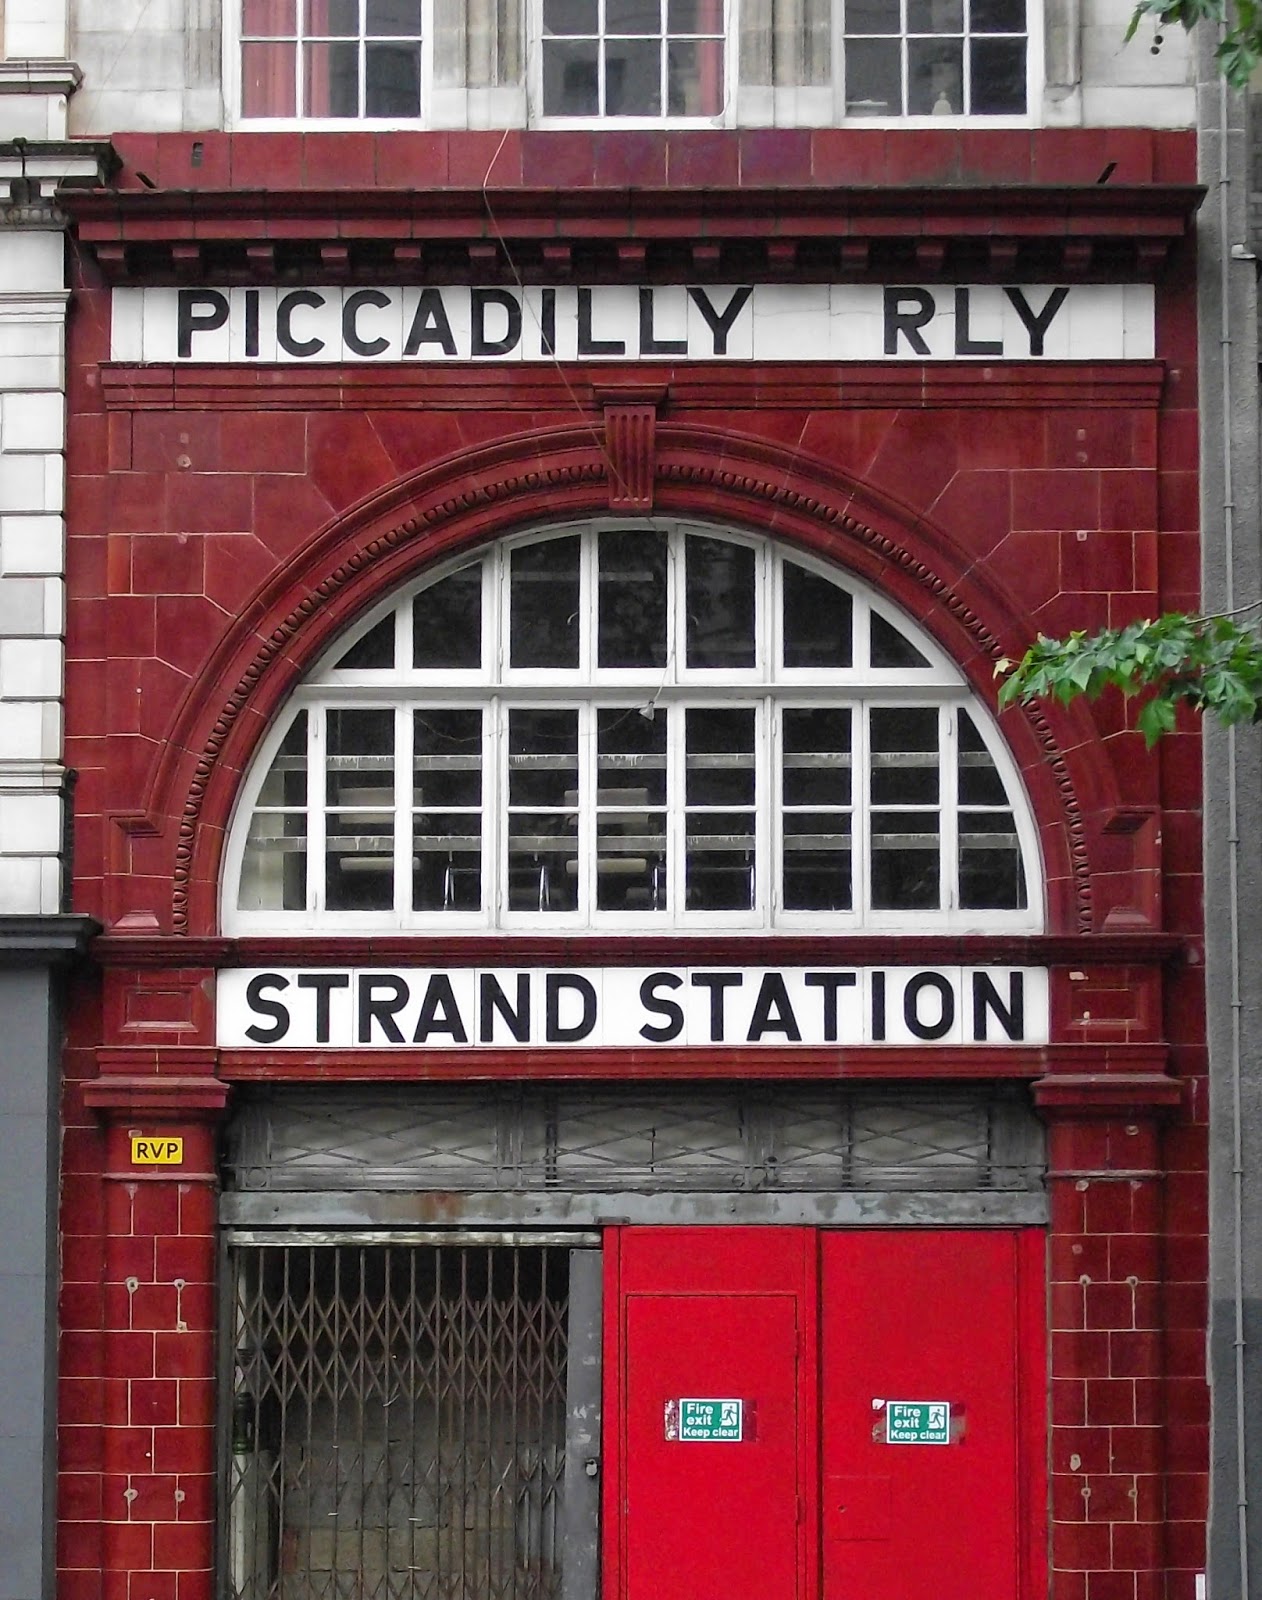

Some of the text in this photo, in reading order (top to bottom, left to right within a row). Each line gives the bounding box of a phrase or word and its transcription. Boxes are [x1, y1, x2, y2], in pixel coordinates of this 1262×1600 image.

[178, 286, 1070, 358] PICCADILLY RLY
[244, 970, 1024, 1044] STRAND STATION
[137, 1142, 179, 1159] RVP
[686, 1402, 714, 1415] Fire
[894, 1405, 921, 1418] Fire
[686, 1414, 712, 1426] exit
[893, 1417, 919, 1429] exit
[683, 1426, 739, 1439] Keep clear
[890, 1429, 946, 1441] Keep clear
